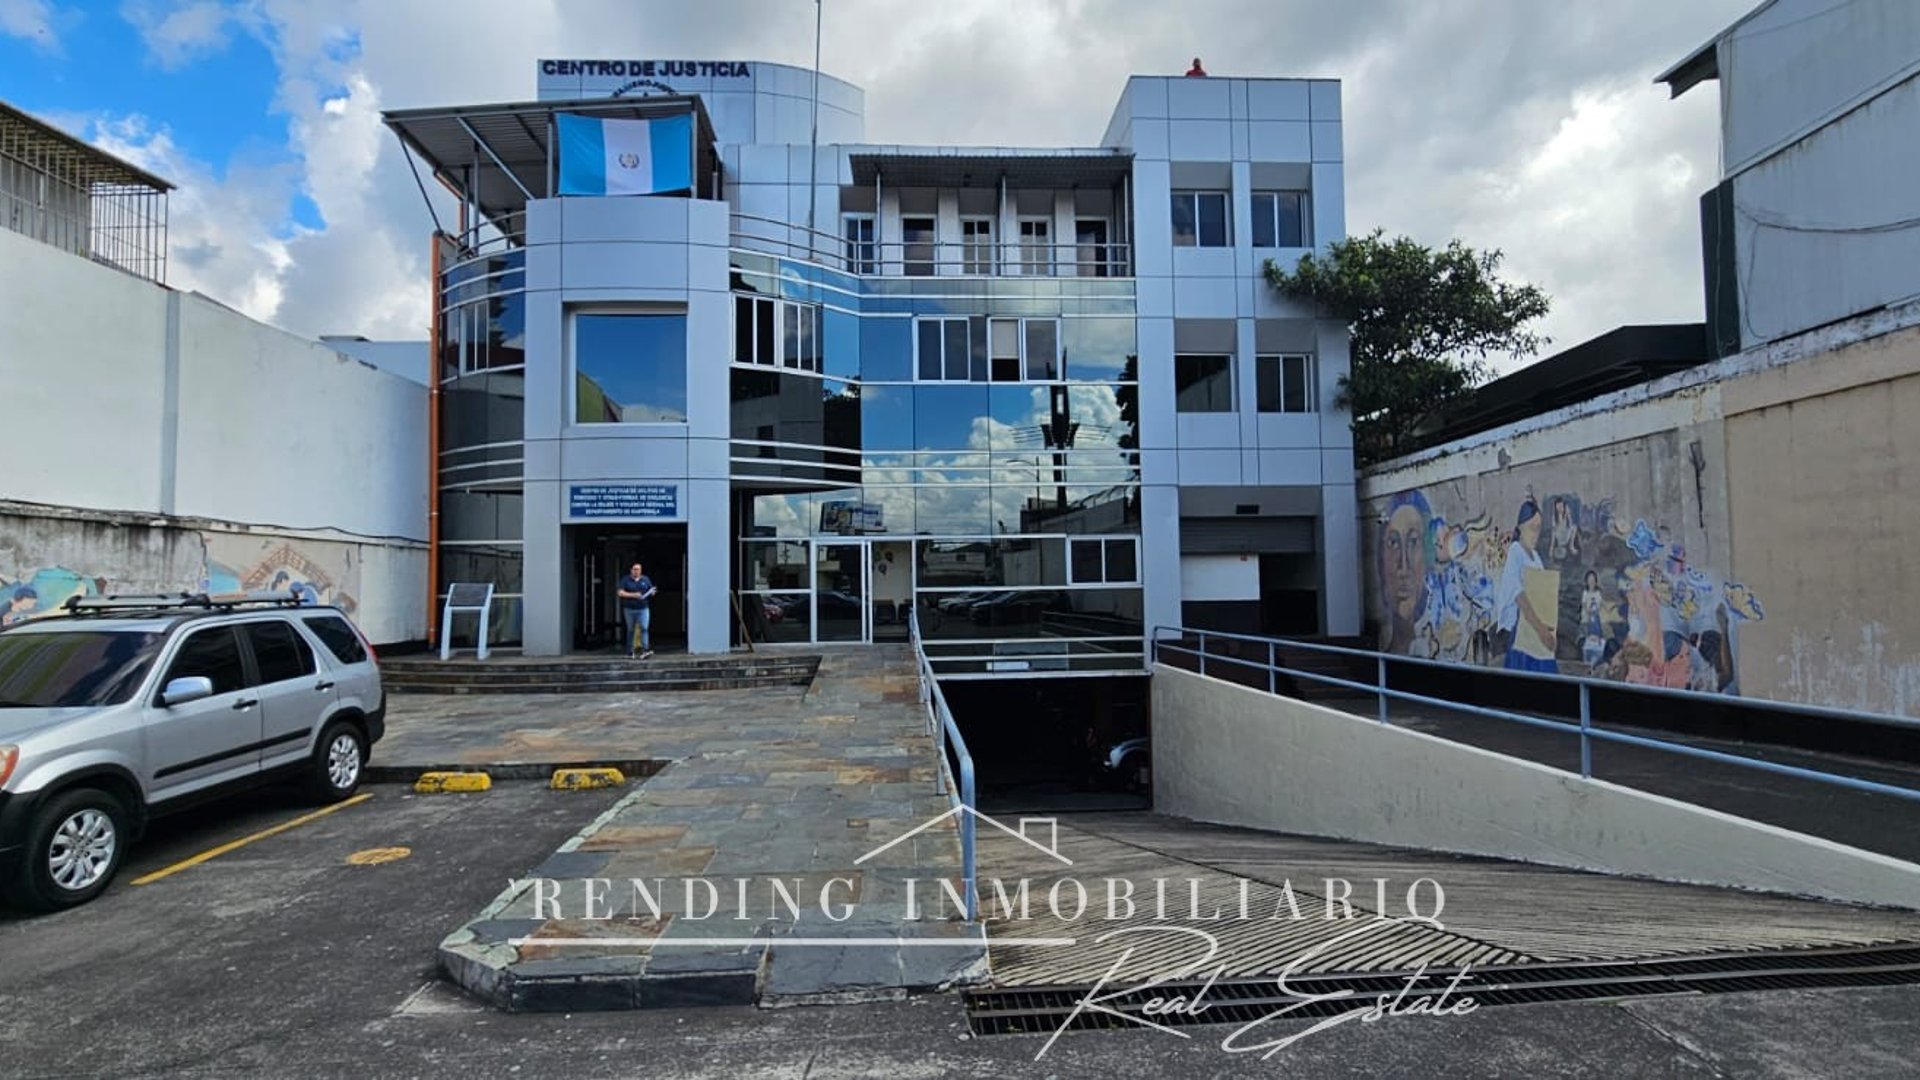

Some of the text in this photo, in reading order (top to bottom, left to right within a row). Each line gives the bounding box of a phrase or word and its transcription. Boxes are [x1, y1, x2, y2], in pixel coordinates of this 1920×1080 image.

[542, 61, 750, 78] CENTRO DE JUSTICIA
